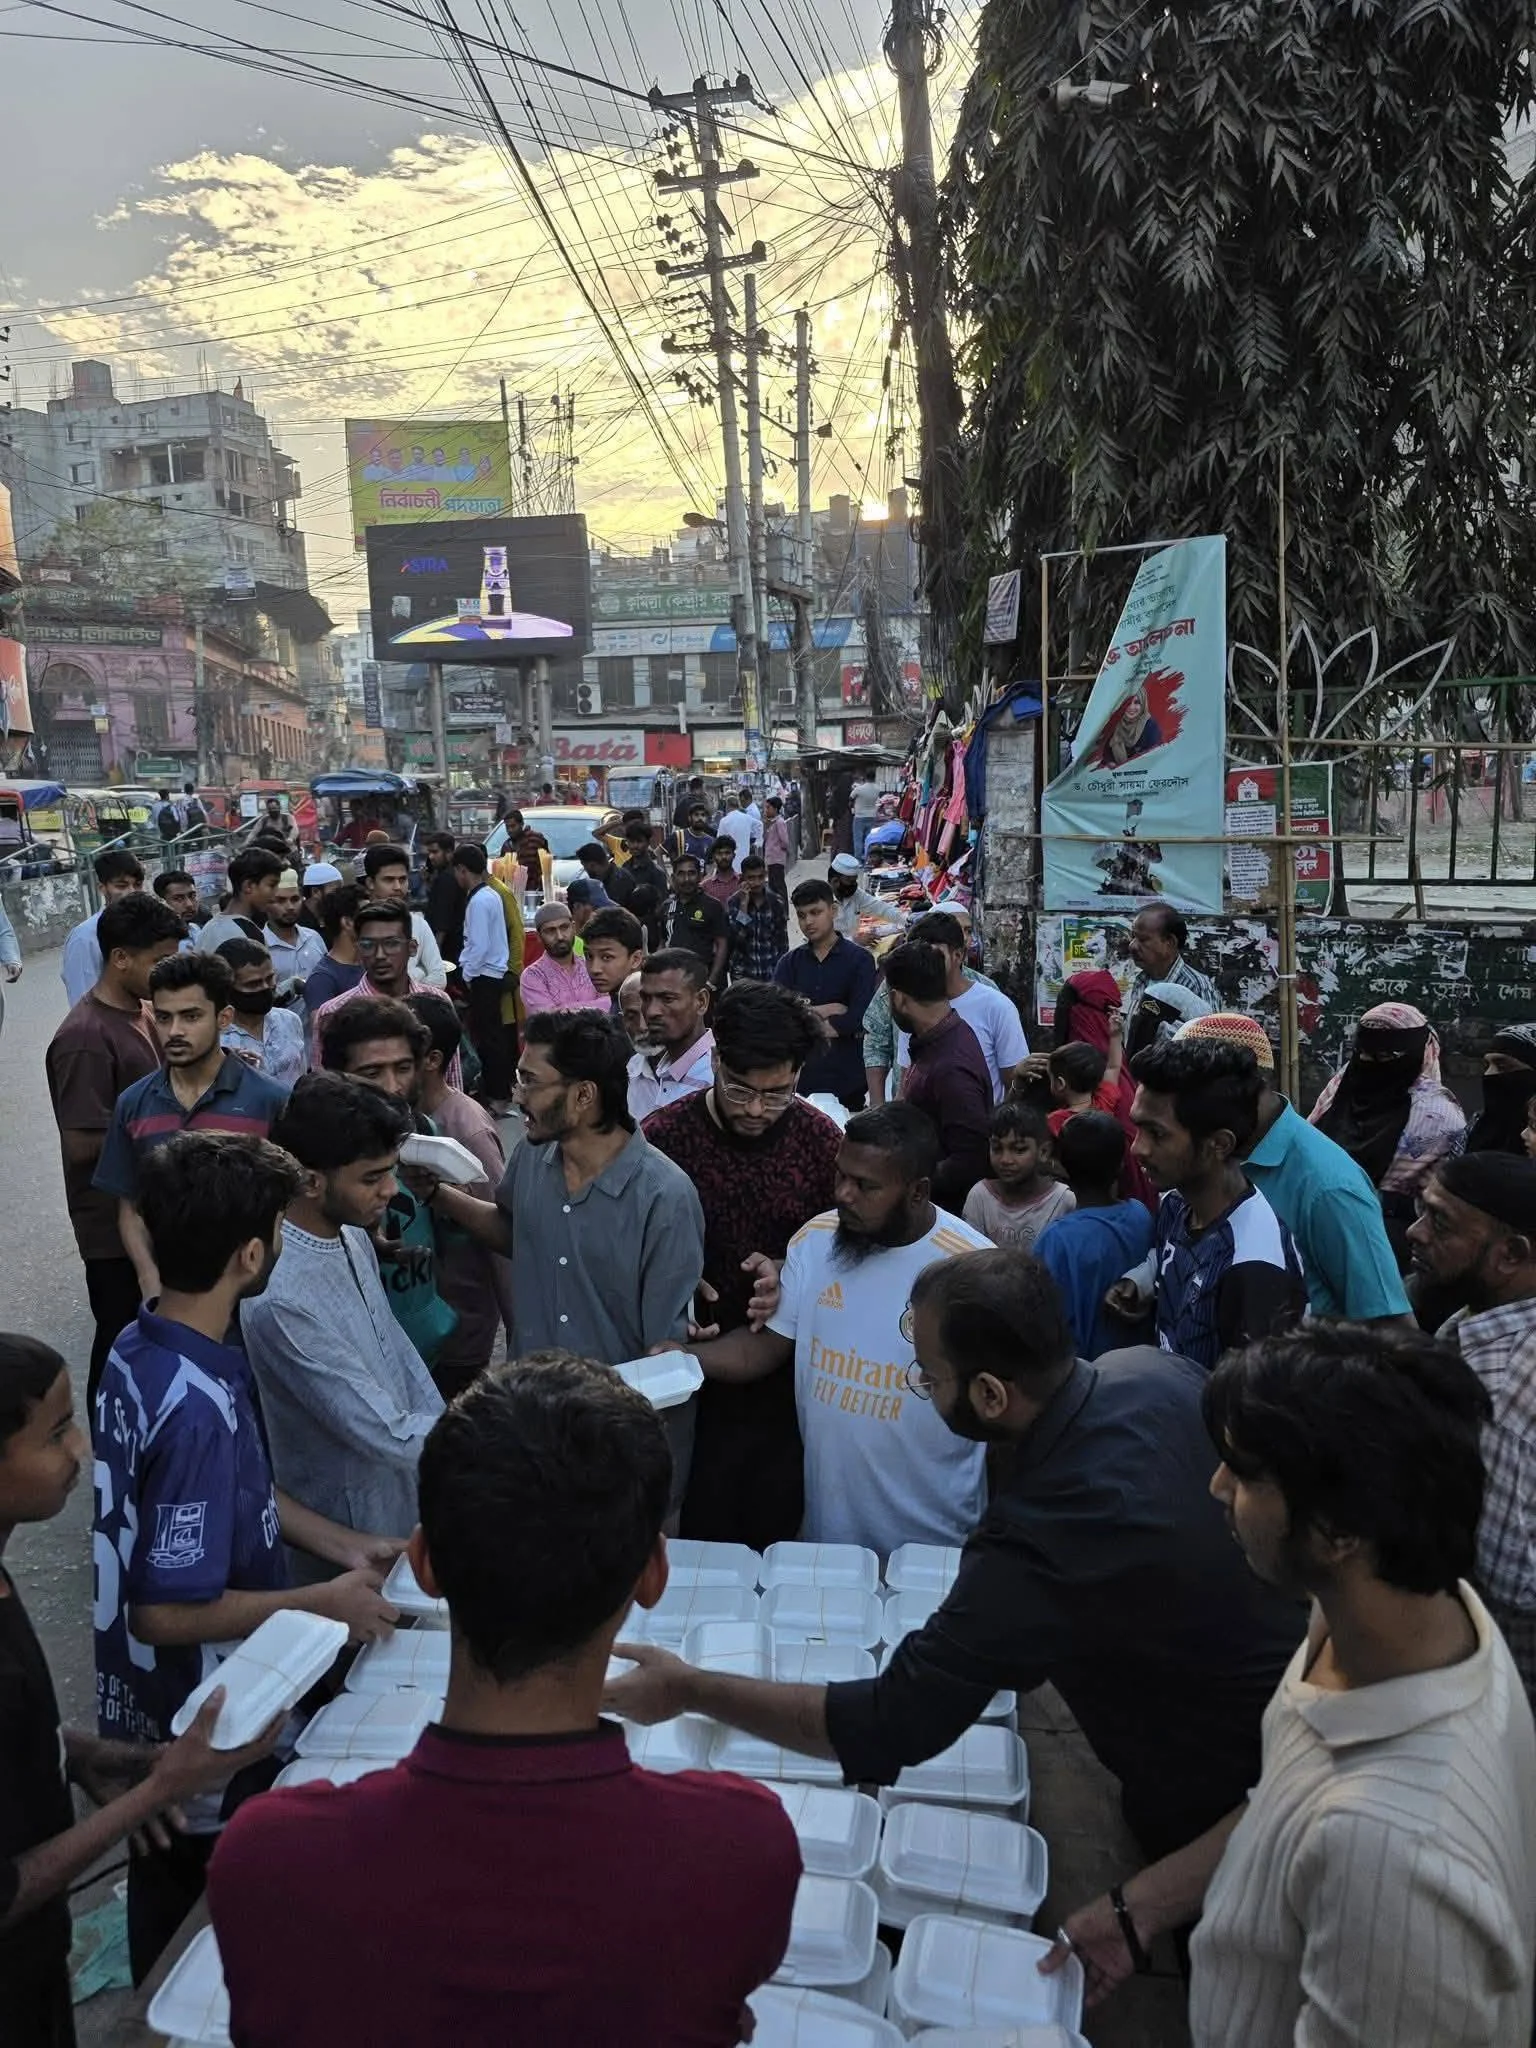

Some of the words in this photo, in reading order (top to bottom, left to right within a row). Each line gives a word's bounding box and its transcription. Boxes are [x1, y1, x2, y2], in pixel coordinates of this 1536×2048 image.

[379, 487, 441, 509] নির্বাচনী
[553, 736, 639, 761] Bata
[813, 1376, 838, 1406] FLY
[840, 1386, 903, 1421] BETTER
